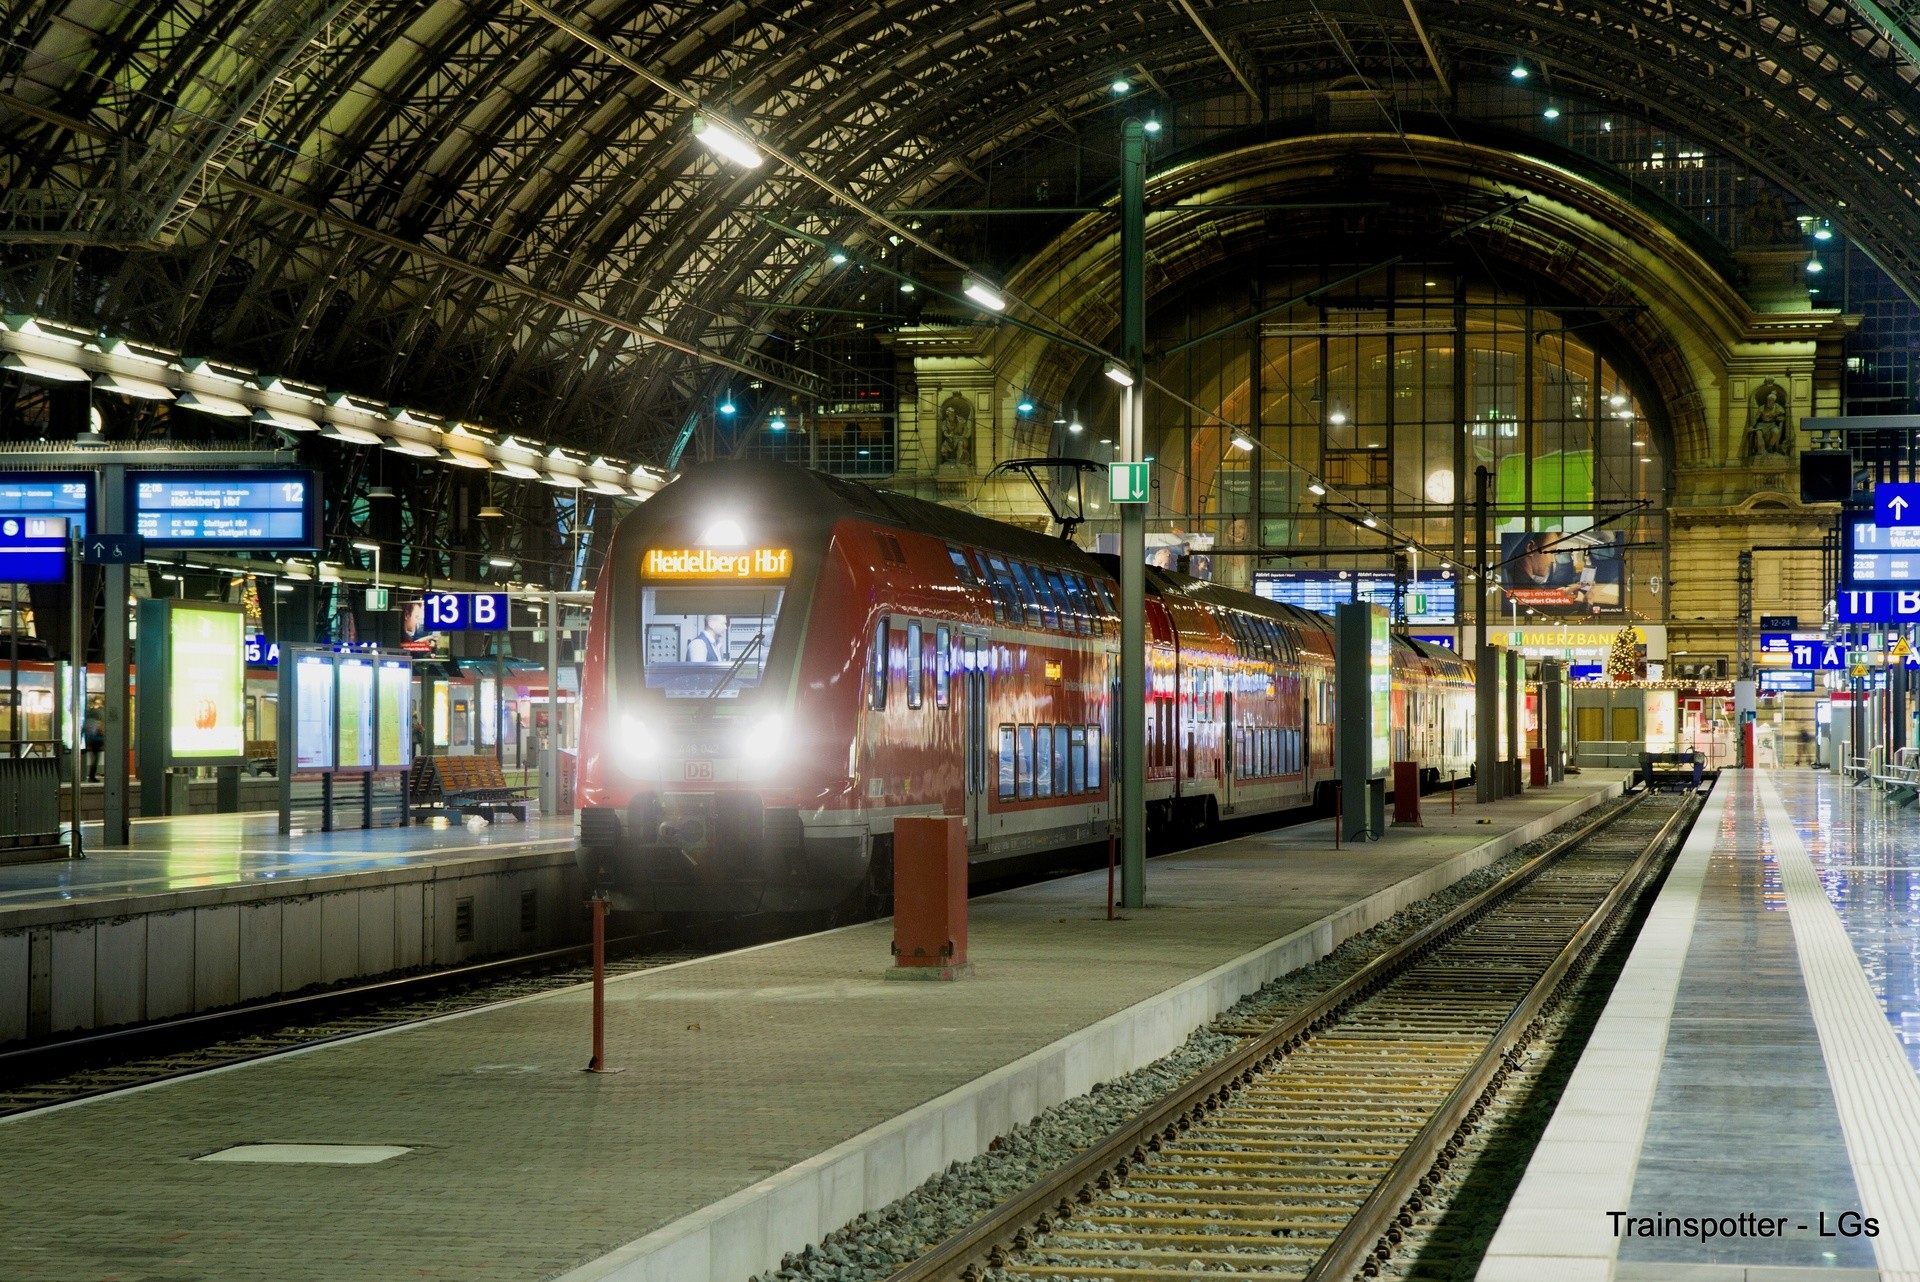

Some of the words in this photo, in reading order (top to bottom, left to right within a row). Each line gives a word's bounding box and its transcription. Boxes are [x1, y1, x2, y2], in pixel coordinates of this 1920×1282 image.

[282, 483, 304, 502] 12
[171, 496, 221, 509] Heidelberg
[223, 496, 240, 507] Hbf
[1855, 524, 1877, 544] 11
[650, 550, 750, 577] Heidelberg
[755, 549, 787, 572] Hbf
[427, 595, 459, 624] 13
[475, 595, 496, 623] B
[1897, 591, 1920, 614] B
[1770, 619, 1791, 627] 12-24
[267, 643, 279, 661] A
[1522, 647, 1538, 656] Die
[1540, 647, 1561, 656] Bank
[1794, 645, 1812, 665] 11
[1823, 645, 1839, 665] A
[1906, 647, 1920, 665] A
[687, 763, 711, 778] DB
